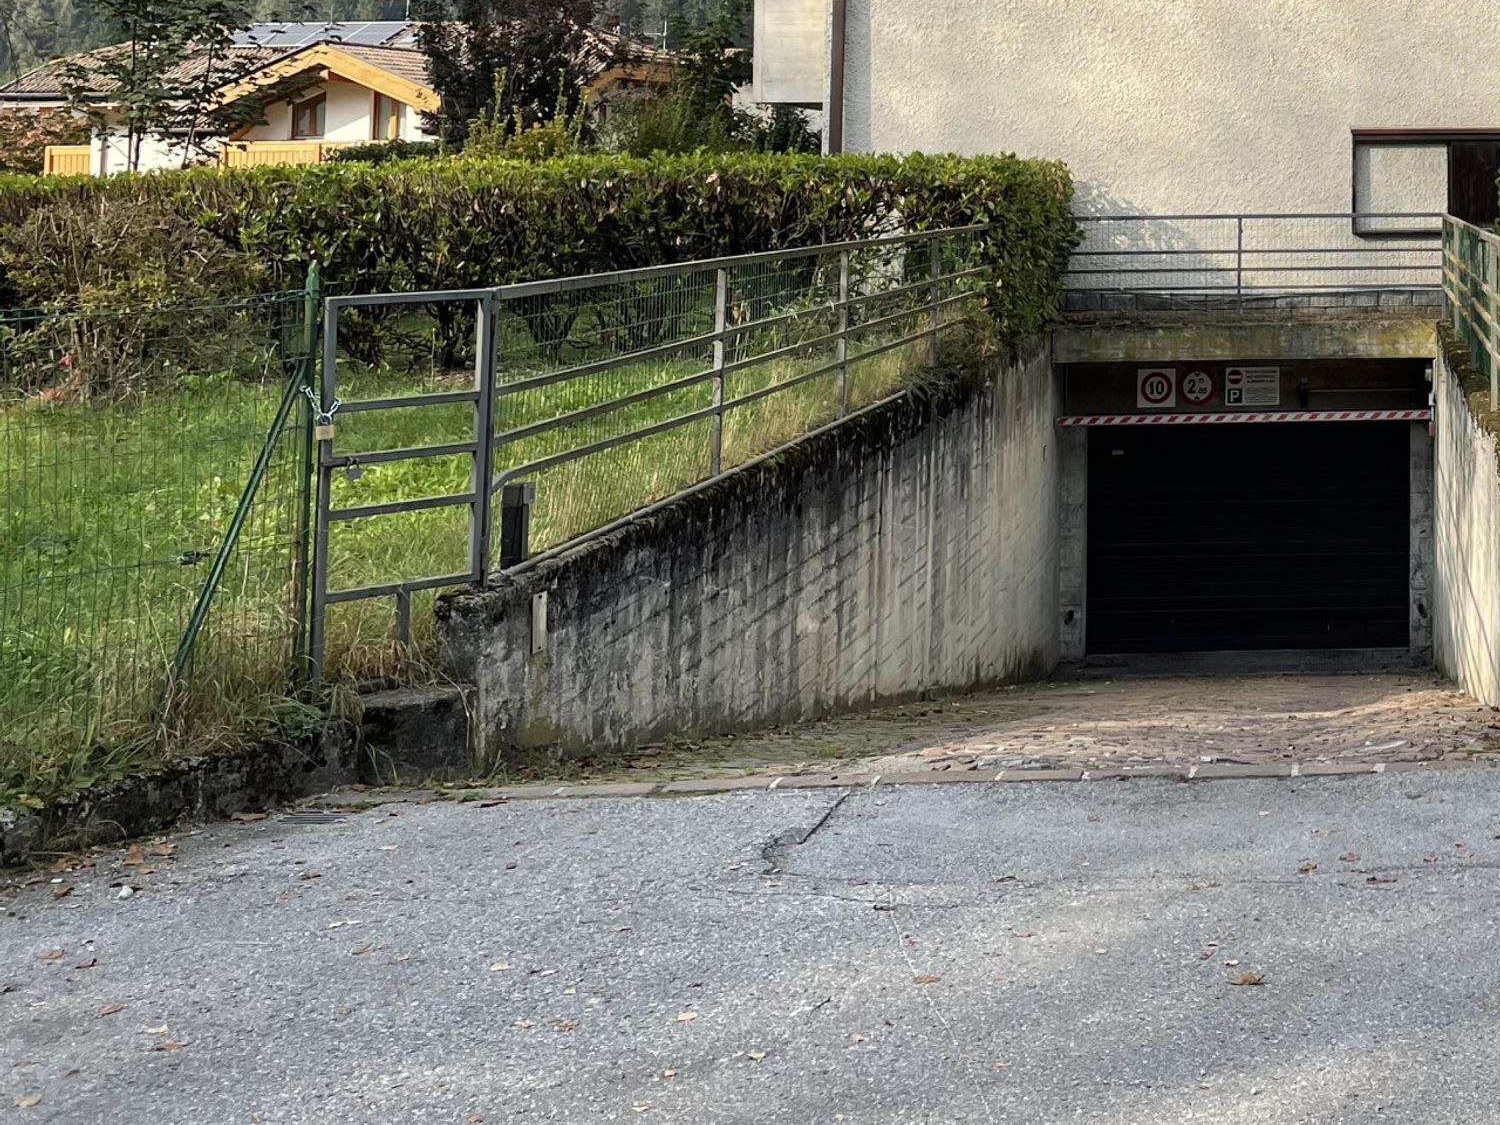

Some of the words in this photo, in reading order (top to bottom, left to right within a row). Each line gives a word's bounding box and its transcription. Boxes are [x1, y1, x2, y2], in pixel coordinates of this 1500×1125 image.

[1148, 380, 1165, 395] 10
[1187, 378, 1196, 394] 2
[1230, 389, 1240, 402] P
